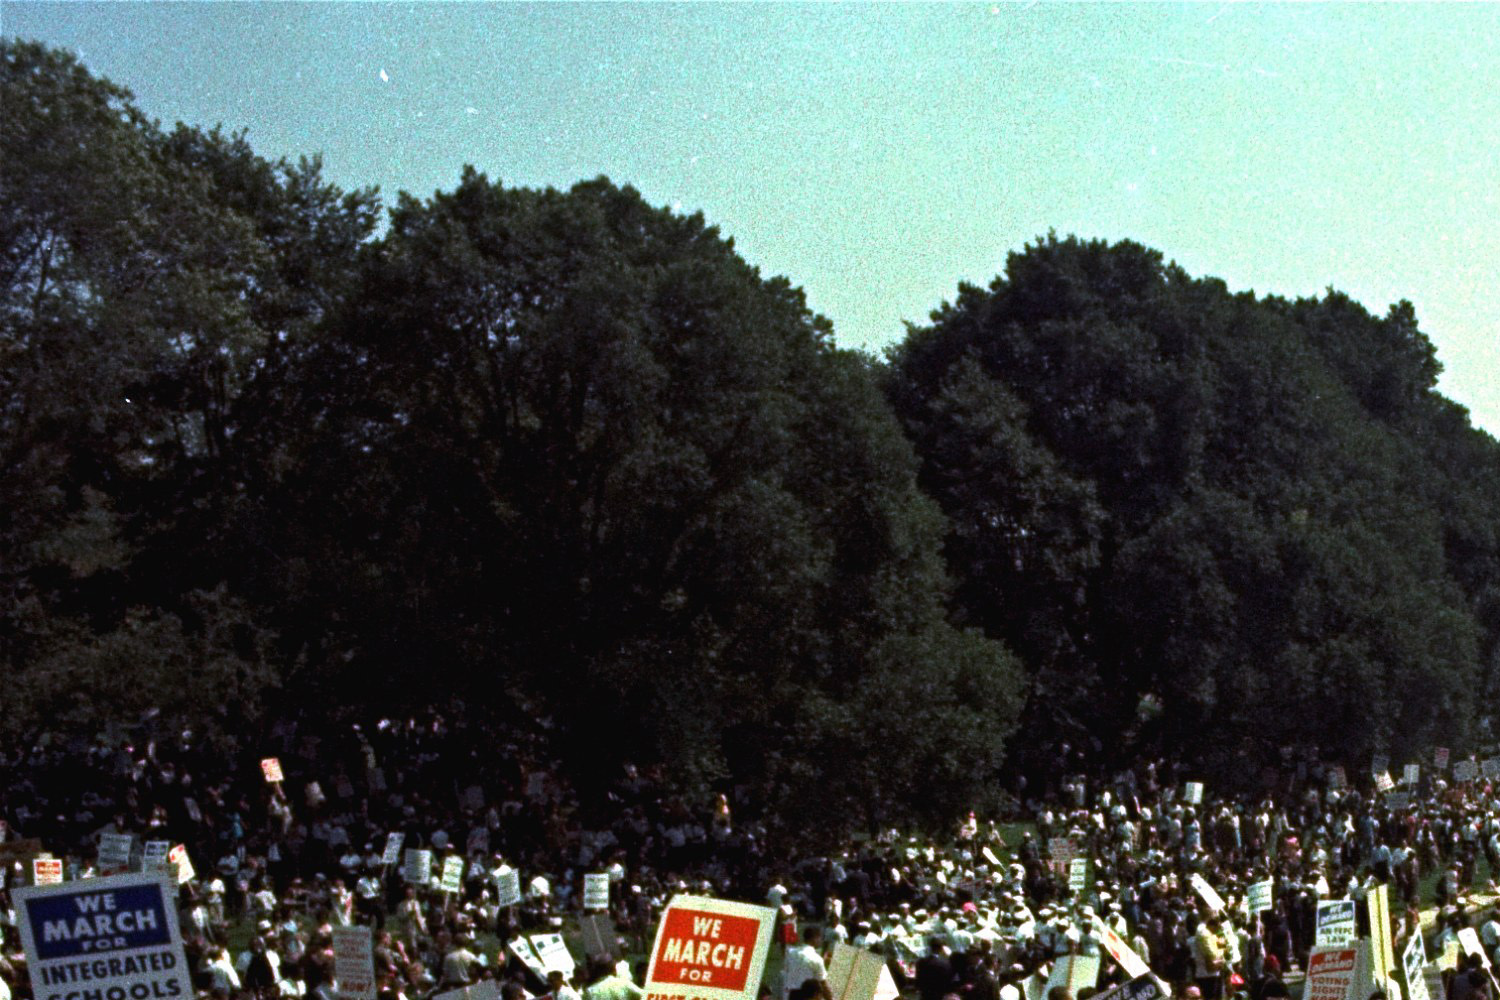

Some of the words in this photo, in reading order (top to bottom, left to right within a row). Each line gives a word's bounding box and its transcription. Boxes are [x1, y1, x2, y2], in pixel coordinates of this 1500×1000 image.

[75, 893, 116, 913] WE
[43, 909, 158, 942] MARCH
[693, 916, 722, 938] WE
[82, 937, 128, 951] FOR
[663, 938, 745, 970] MARCH
[41, 952, 176, 986] INTEGRATED
[679, 967, 712, 982] FOR
